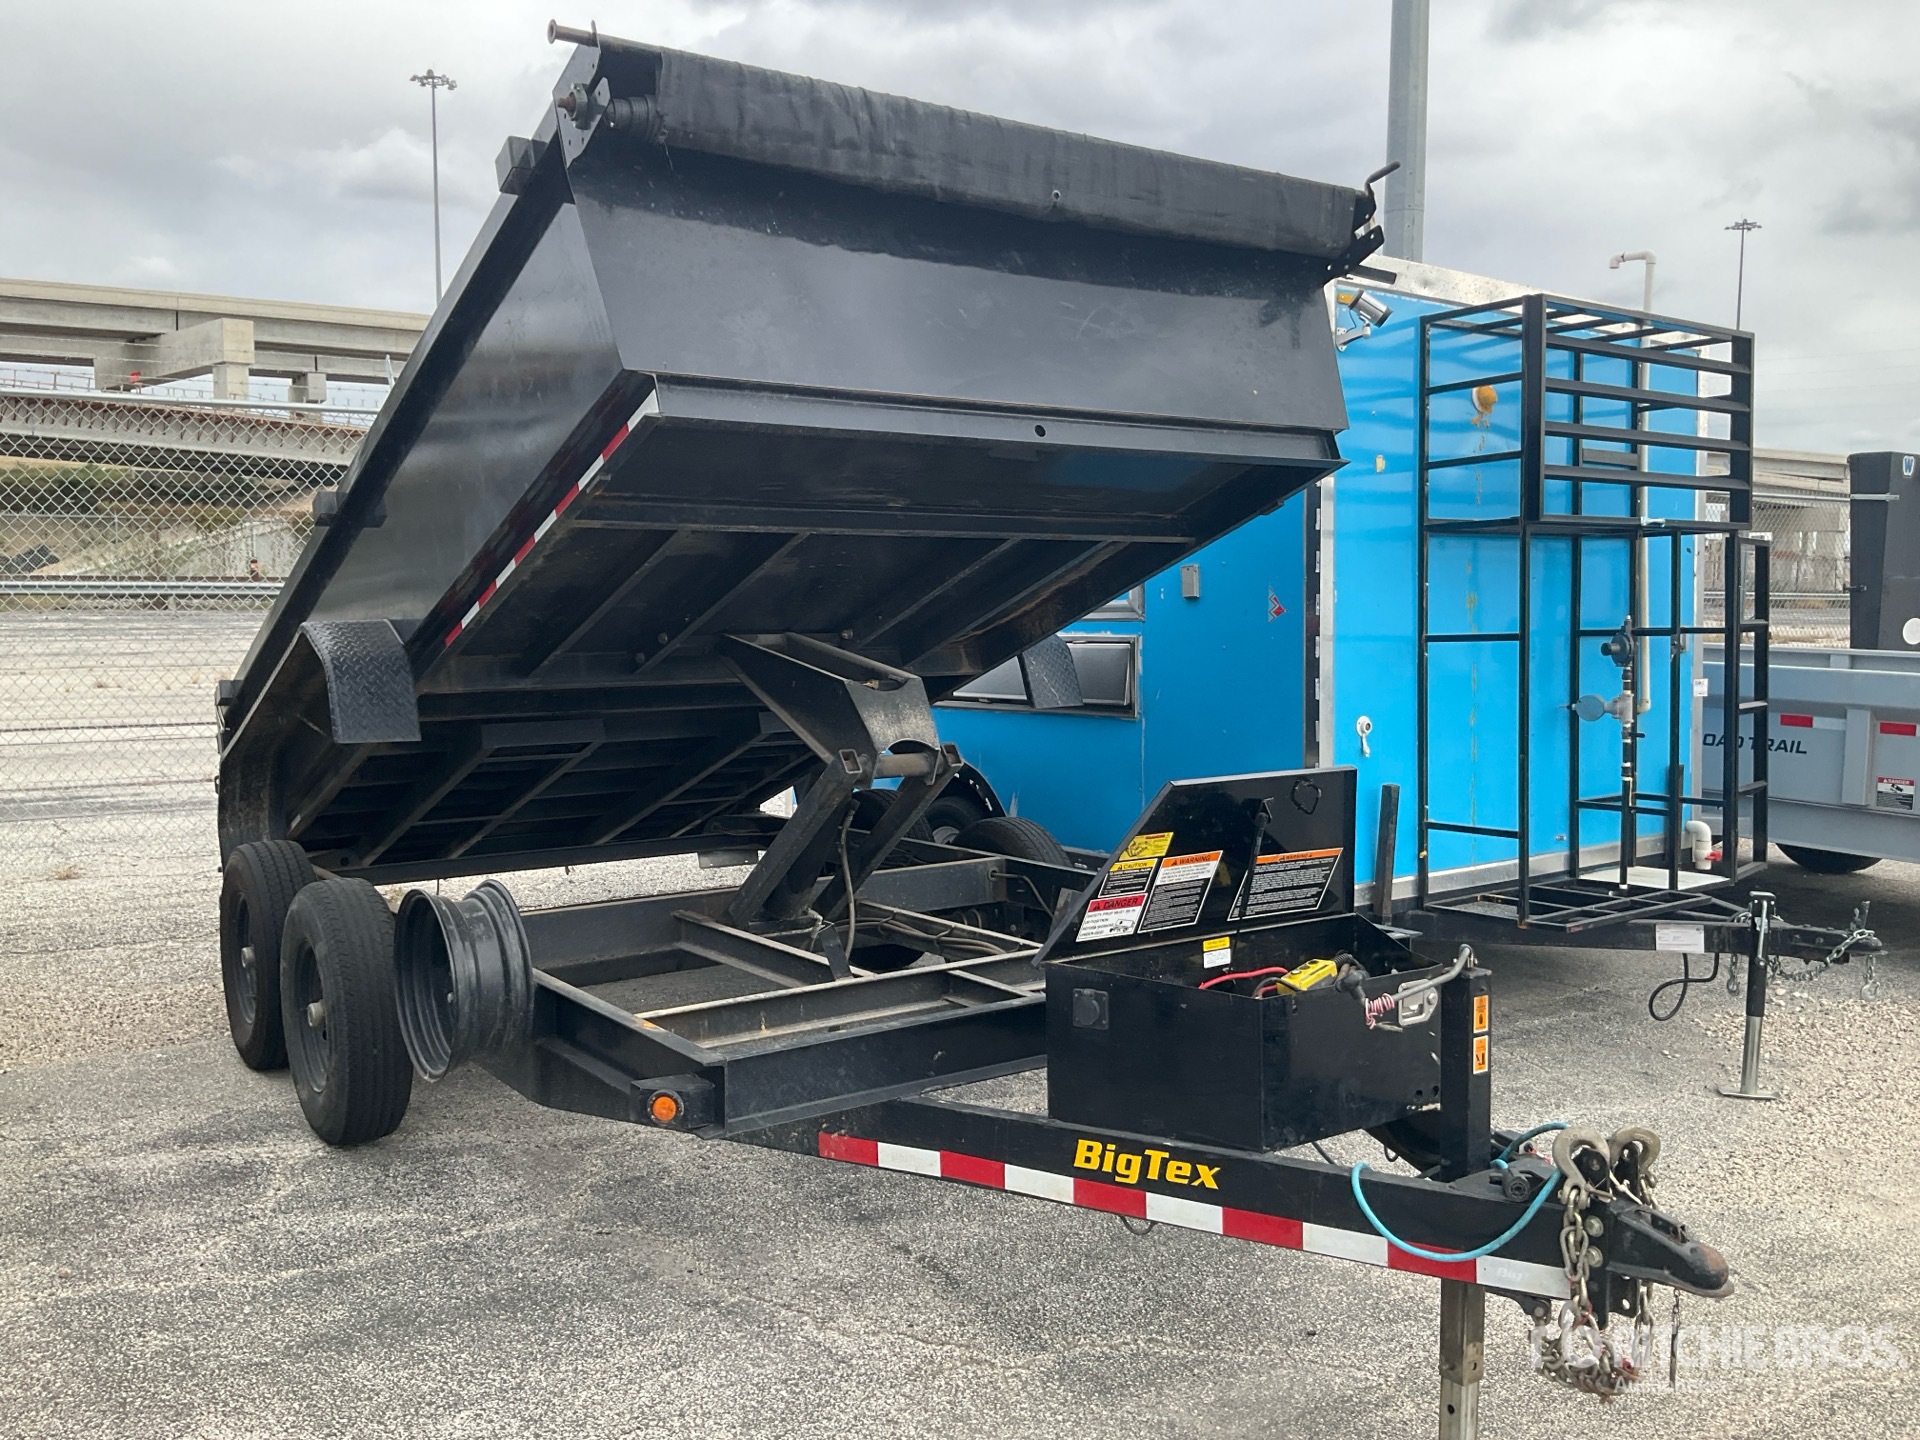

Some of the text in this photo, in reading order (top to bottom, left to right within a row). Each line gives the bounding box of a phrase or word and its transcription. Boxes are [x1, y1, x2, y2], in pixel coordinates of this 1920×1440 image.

[1179, 854, 1211, 864] WARNING
[1123, 862, 1148, 870] CAUTION
[1103, 897, 1139, 910] DANGER
[1073, 1139, 1221, 1190] BigTex
